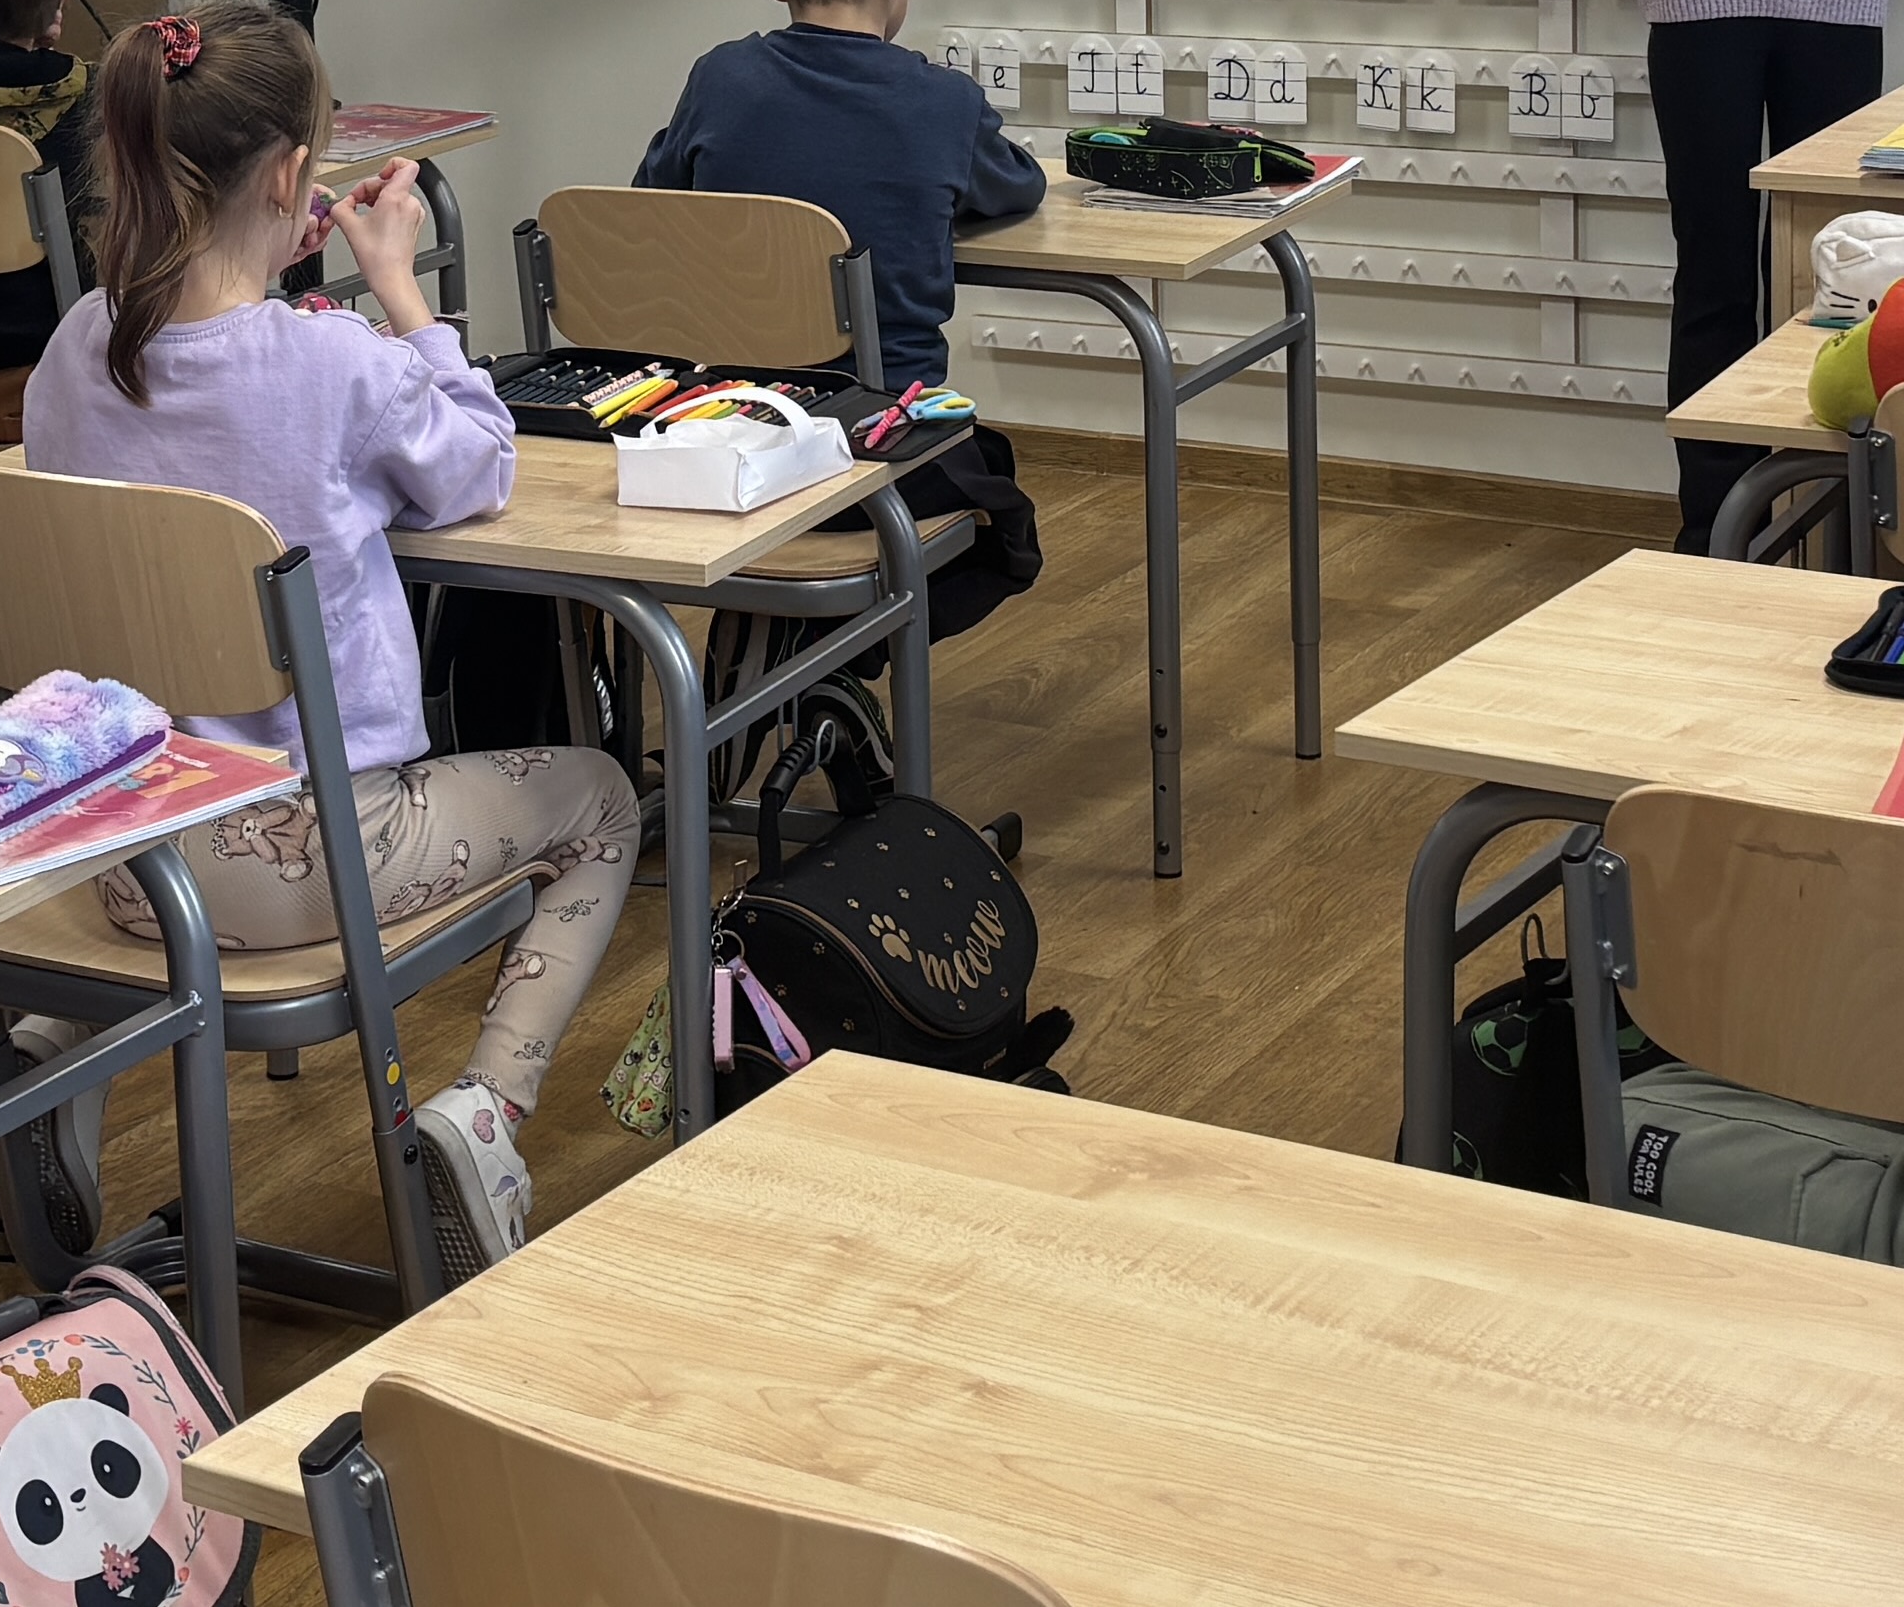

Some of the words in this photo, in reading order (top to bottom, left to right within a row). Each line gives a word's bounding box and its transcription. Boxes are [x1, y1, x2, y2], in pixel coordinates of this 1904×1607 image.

[993, 67, 1005, 88] e
[1214, 59, 1250, 100] D
[1270, 61, 1295, 103] d
[1364, 65, 1393, 109] K
[1421, 68, 1441, 111] k
[1517, 74, 1549, 116] B
[917, 899, 1007, 995] meow
[1650, 1135, 1669, 1159] TOO
[1644, 1162, 1657, 1195] COOL
